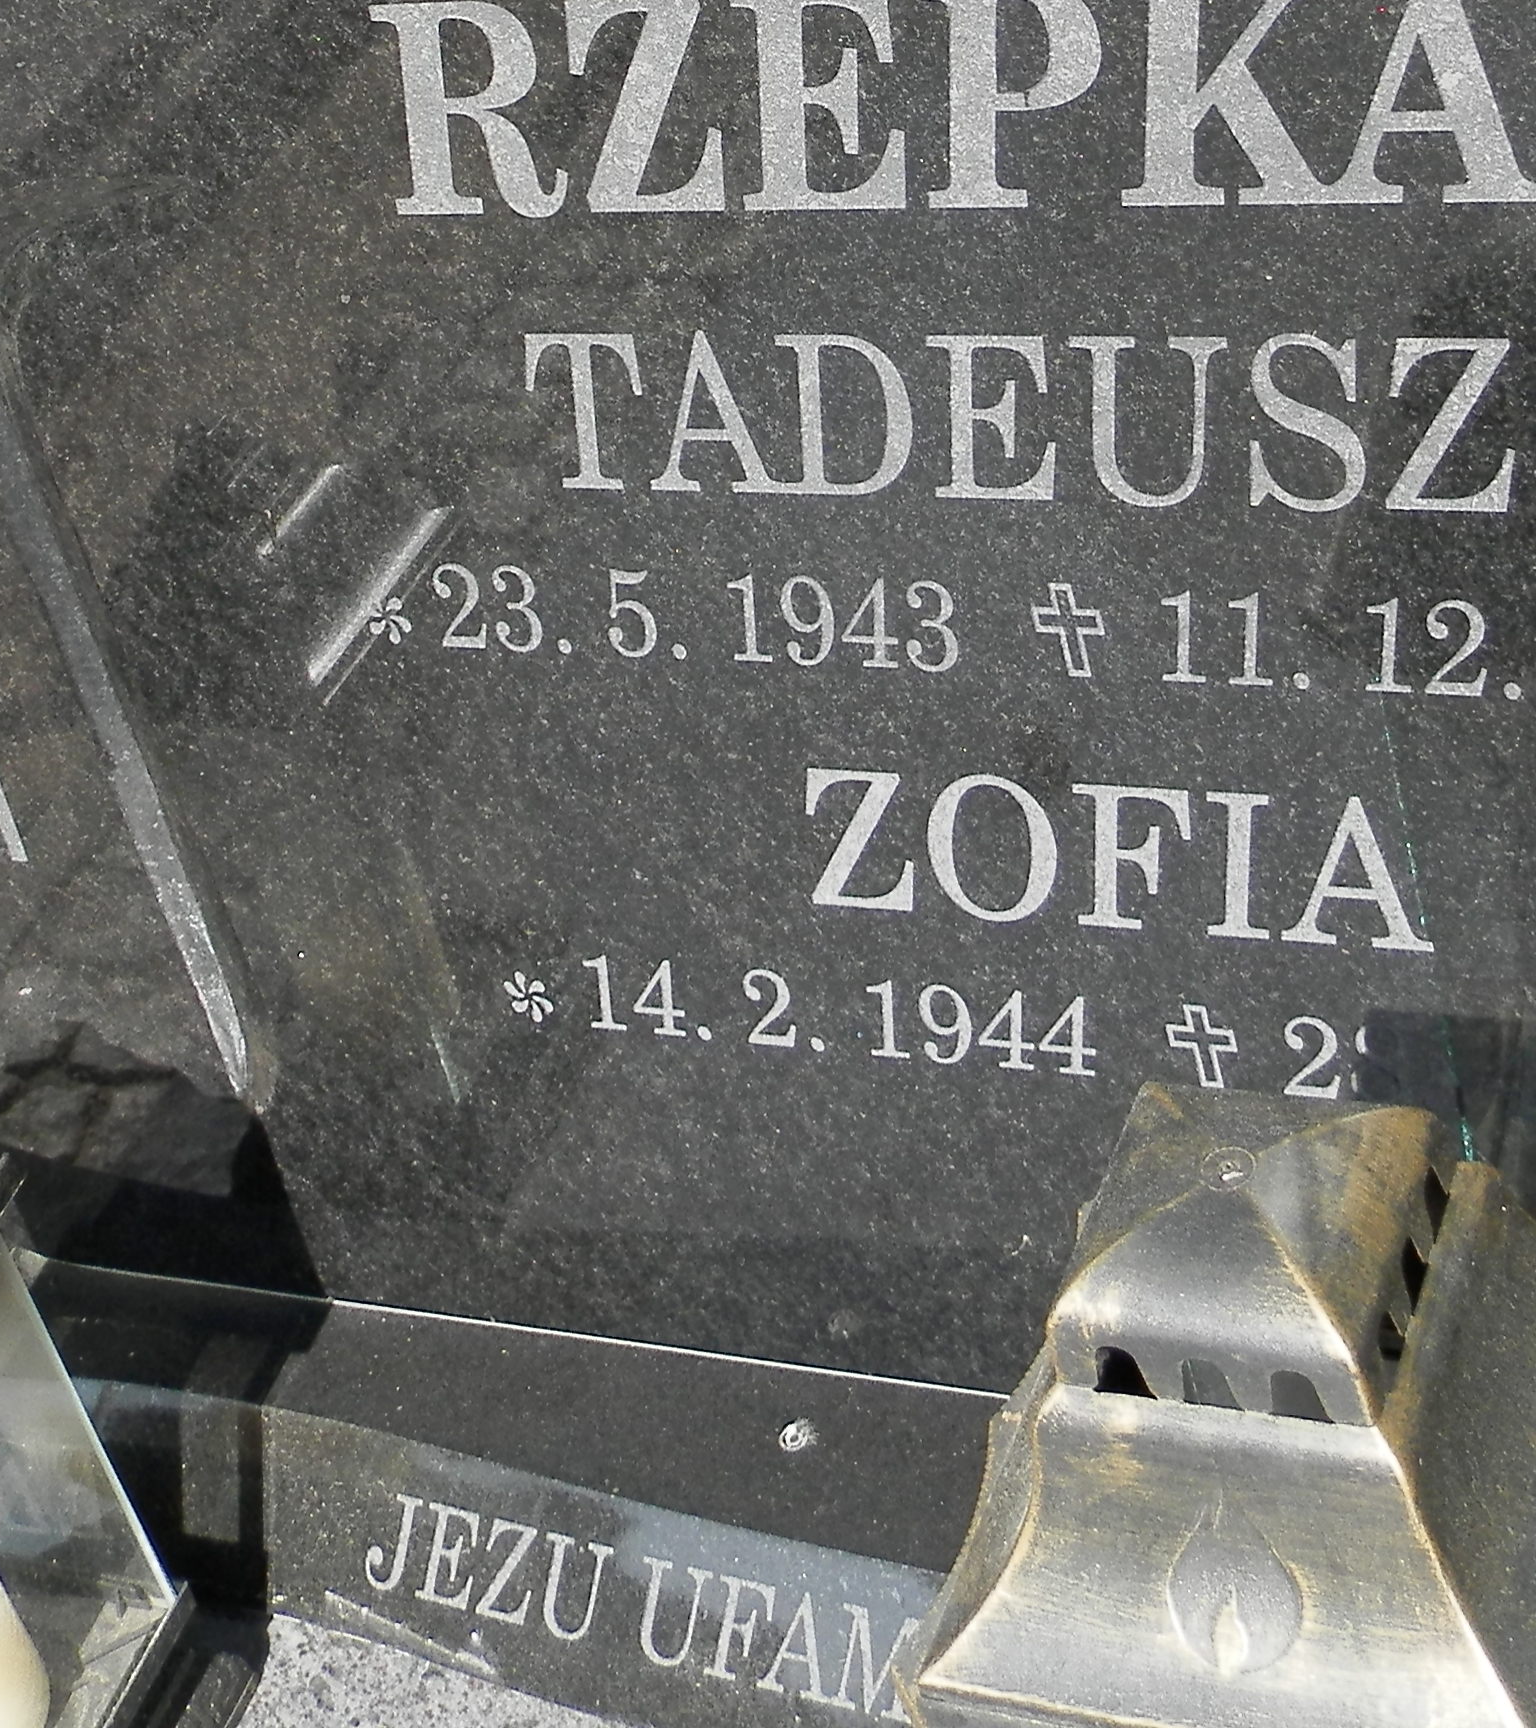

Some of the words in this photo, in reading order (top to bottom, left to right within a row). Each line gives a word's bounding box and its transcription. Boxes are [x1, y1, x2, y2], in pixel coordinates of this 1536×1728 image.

[523, 330, 1515, 514] TADEUSZ
[608, 569, 688, 660] 5.
[726, 573, 960, 672] 1943
[1365, 597, 1522, 701] 12.
[802, 767, 1434, 955] ZOFIA
[742, 969, 825, 1052] 2.
[865, 979, 1097, 1077] 1944
[365, 1493, 614, 1641] JEZU
[640, 1555, 922, 1725] UFAM
